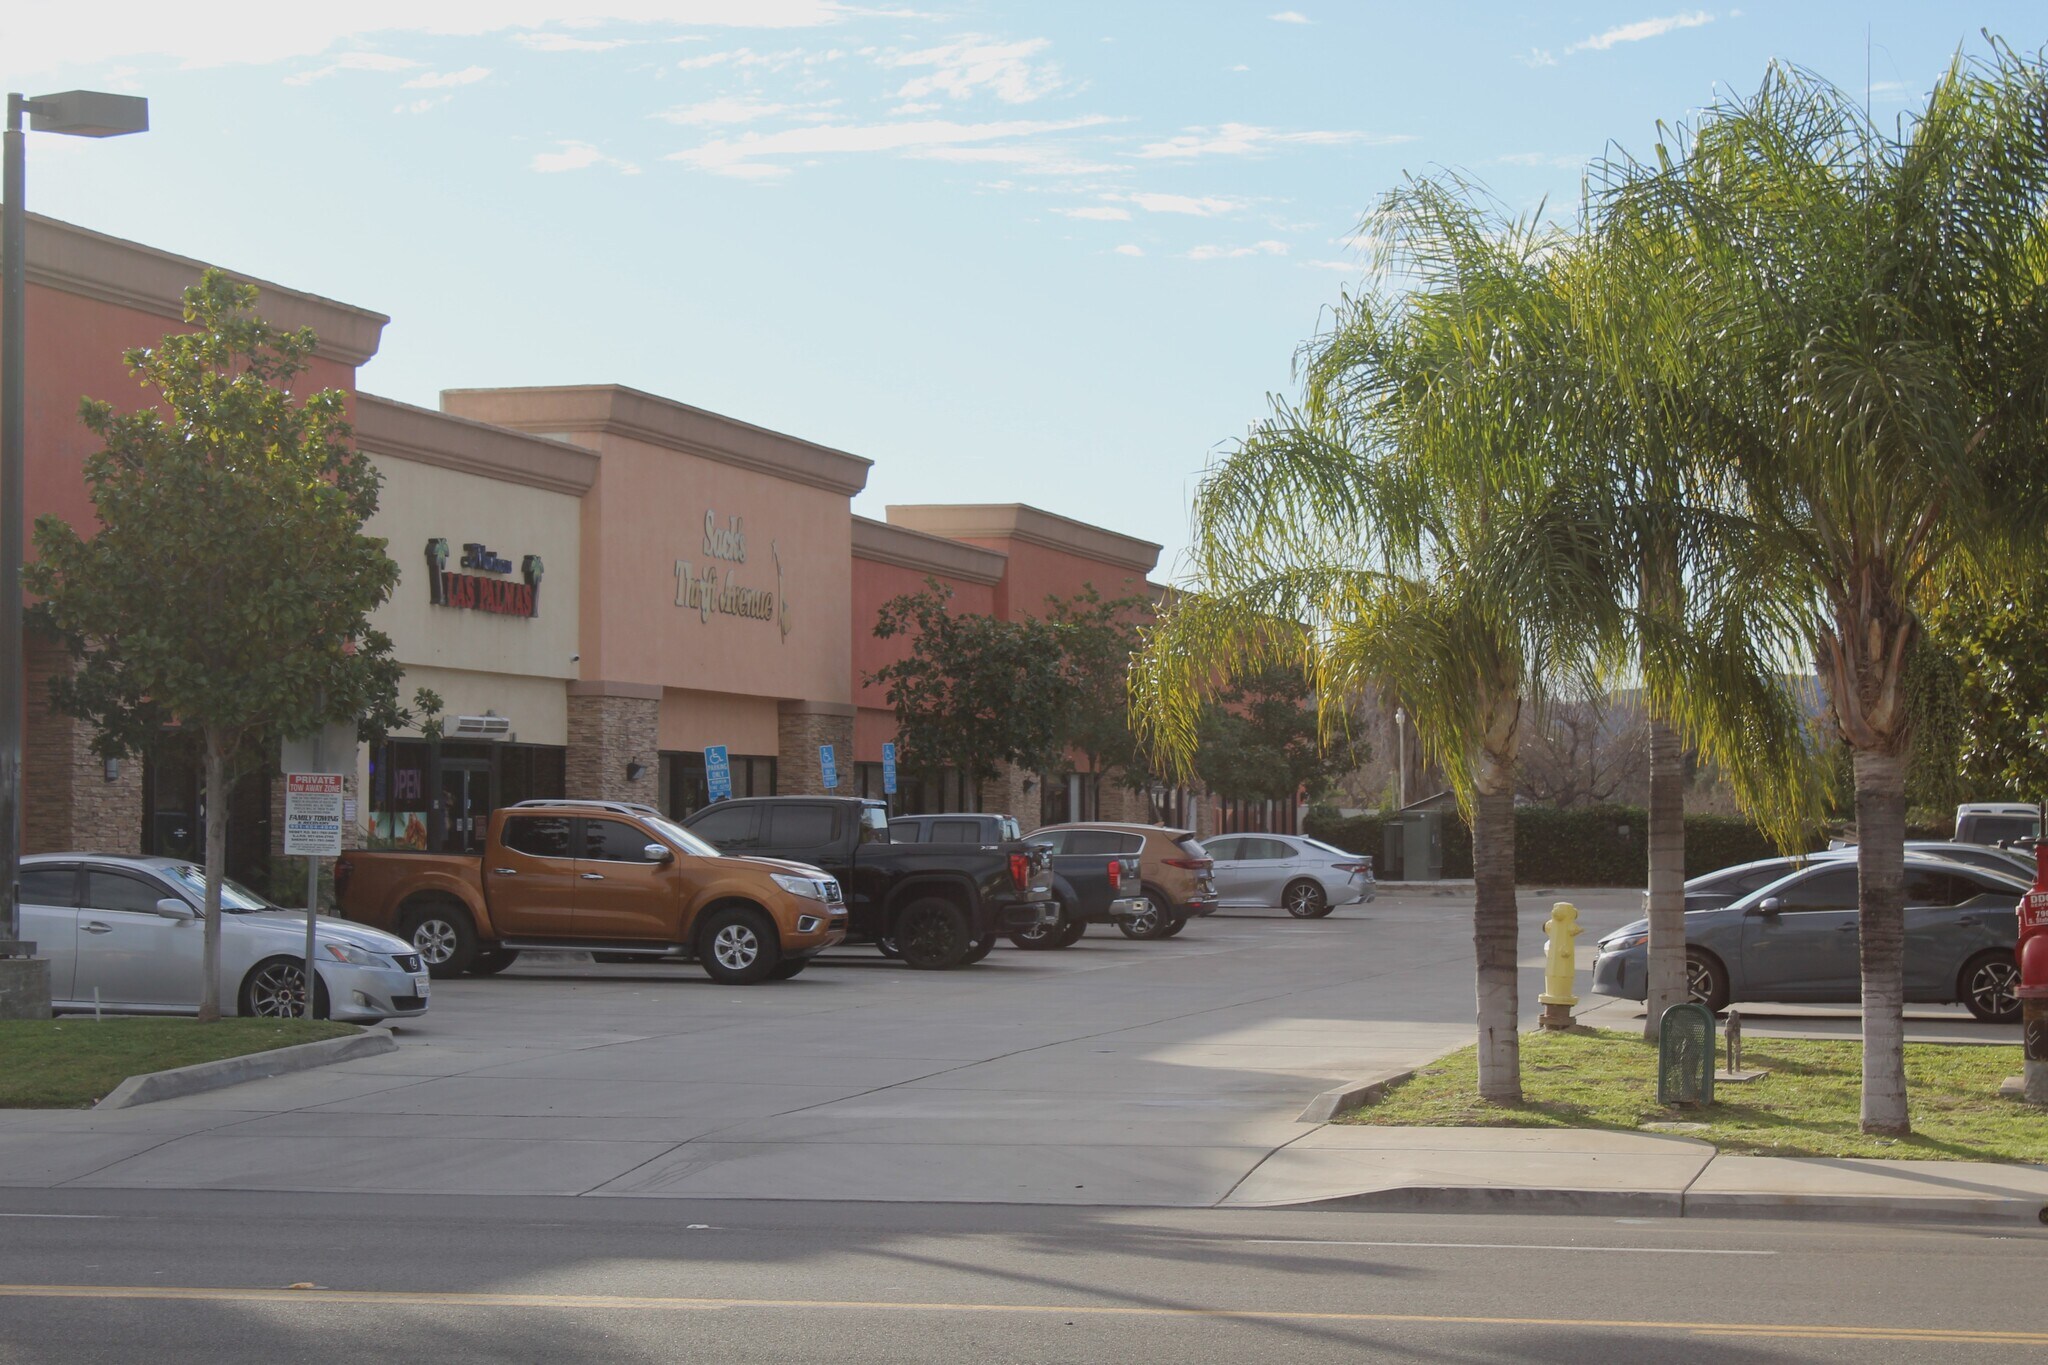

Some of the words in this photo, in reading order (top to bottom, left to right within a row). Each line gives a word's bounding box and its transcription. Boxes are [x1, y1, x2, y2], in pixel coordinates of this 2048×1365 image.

[446, 572, 476, 609] LAS
[479, 576, 533, 617] PALMAS
[674, 560, 718, 624] Thrift
[718, 569, 773, 621] Avenue
[290, 784, 304, 792] TOW
[305, 784, 323, 792] AWAY
[324, 785, 340, 793] ZONE
[295, 775, 335, 785] PRIVATE
